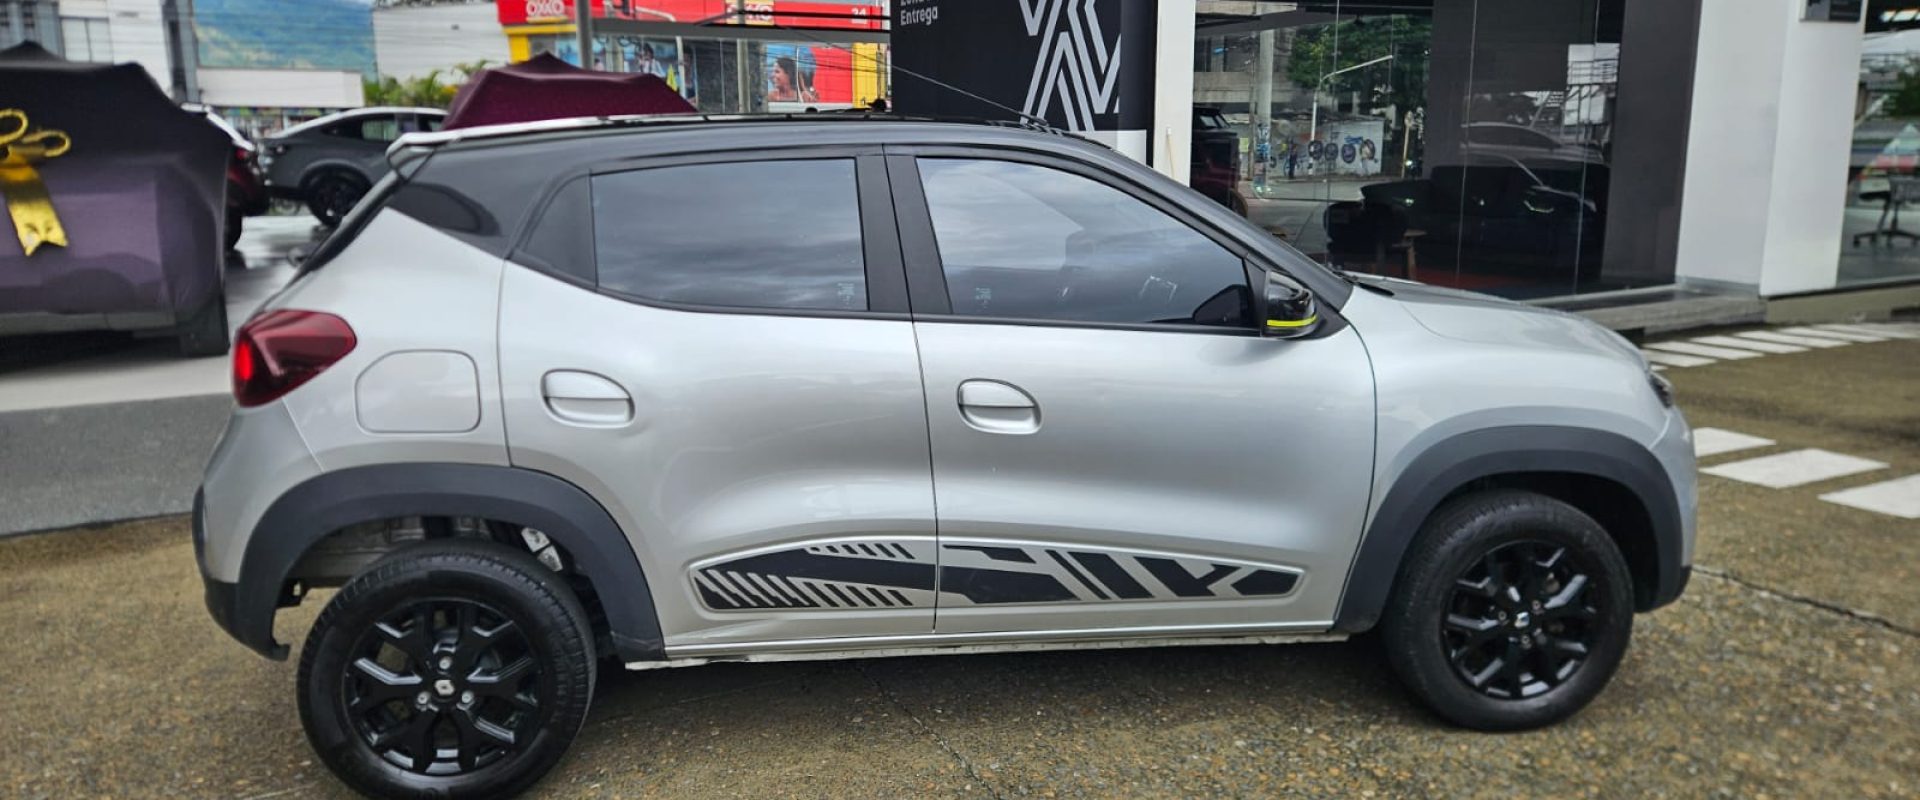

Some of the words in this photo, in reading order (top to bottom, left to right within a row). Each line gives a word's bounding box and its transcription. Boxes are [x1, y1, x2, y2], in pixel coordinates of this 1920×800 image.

[526, 0, 565, 16] OXXO
[726, 4, 774, 20] OXO
[900, 6, 938, 26] Entrega
